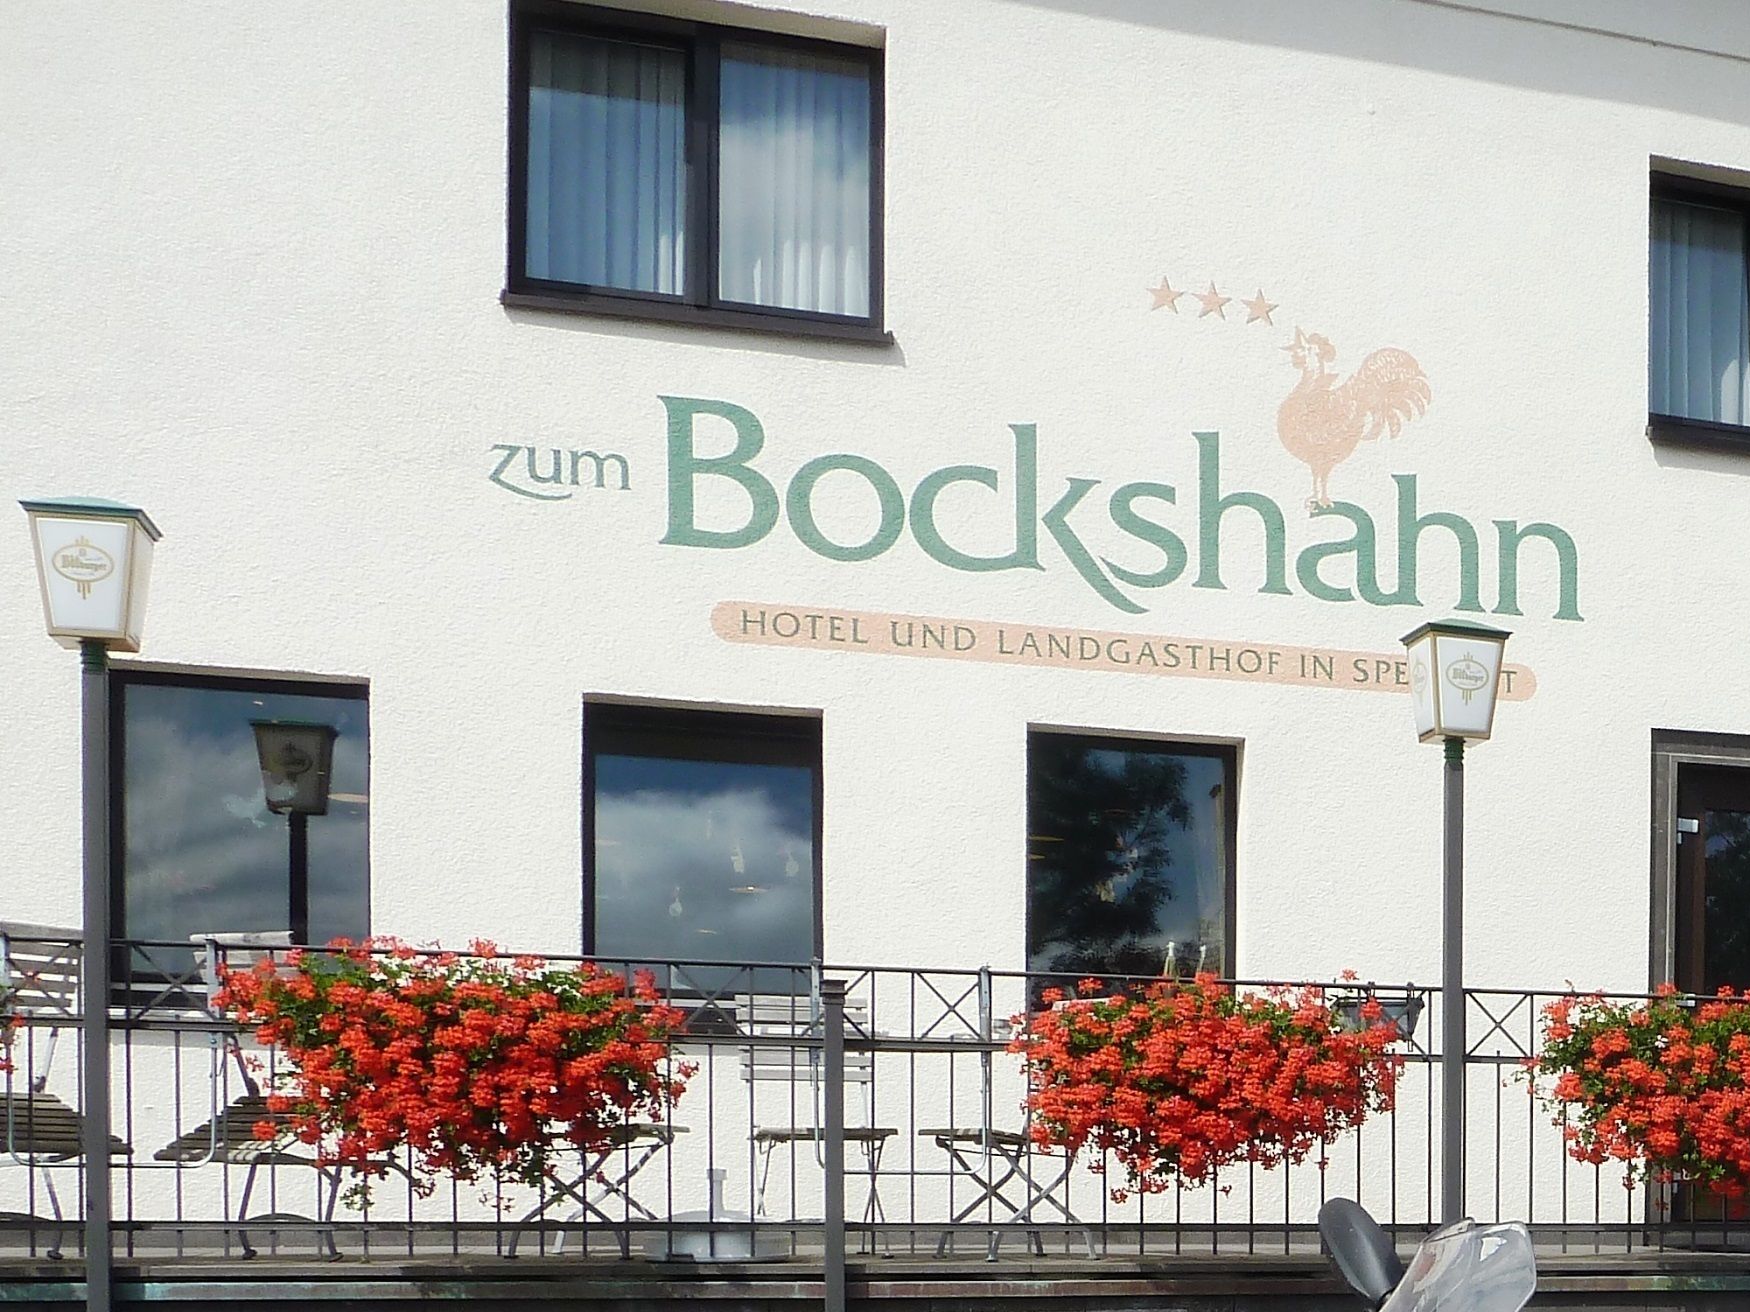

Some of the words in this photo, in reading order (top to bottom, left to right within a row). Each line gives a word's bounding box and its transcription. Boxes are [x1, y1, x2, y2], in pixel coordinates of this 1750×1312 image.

[487, 443, 632, 501] zum
[656, 395, 1586, 624] Bockshahn
[740, 608, 869, 645] HOTEL
[889, 620, 978, 652] UND
[997, 629, 1282, 677] LANDGASTHOF
[1299, 653, 1336, 681] IN
[1352, 658, 1518, 694] SPET
